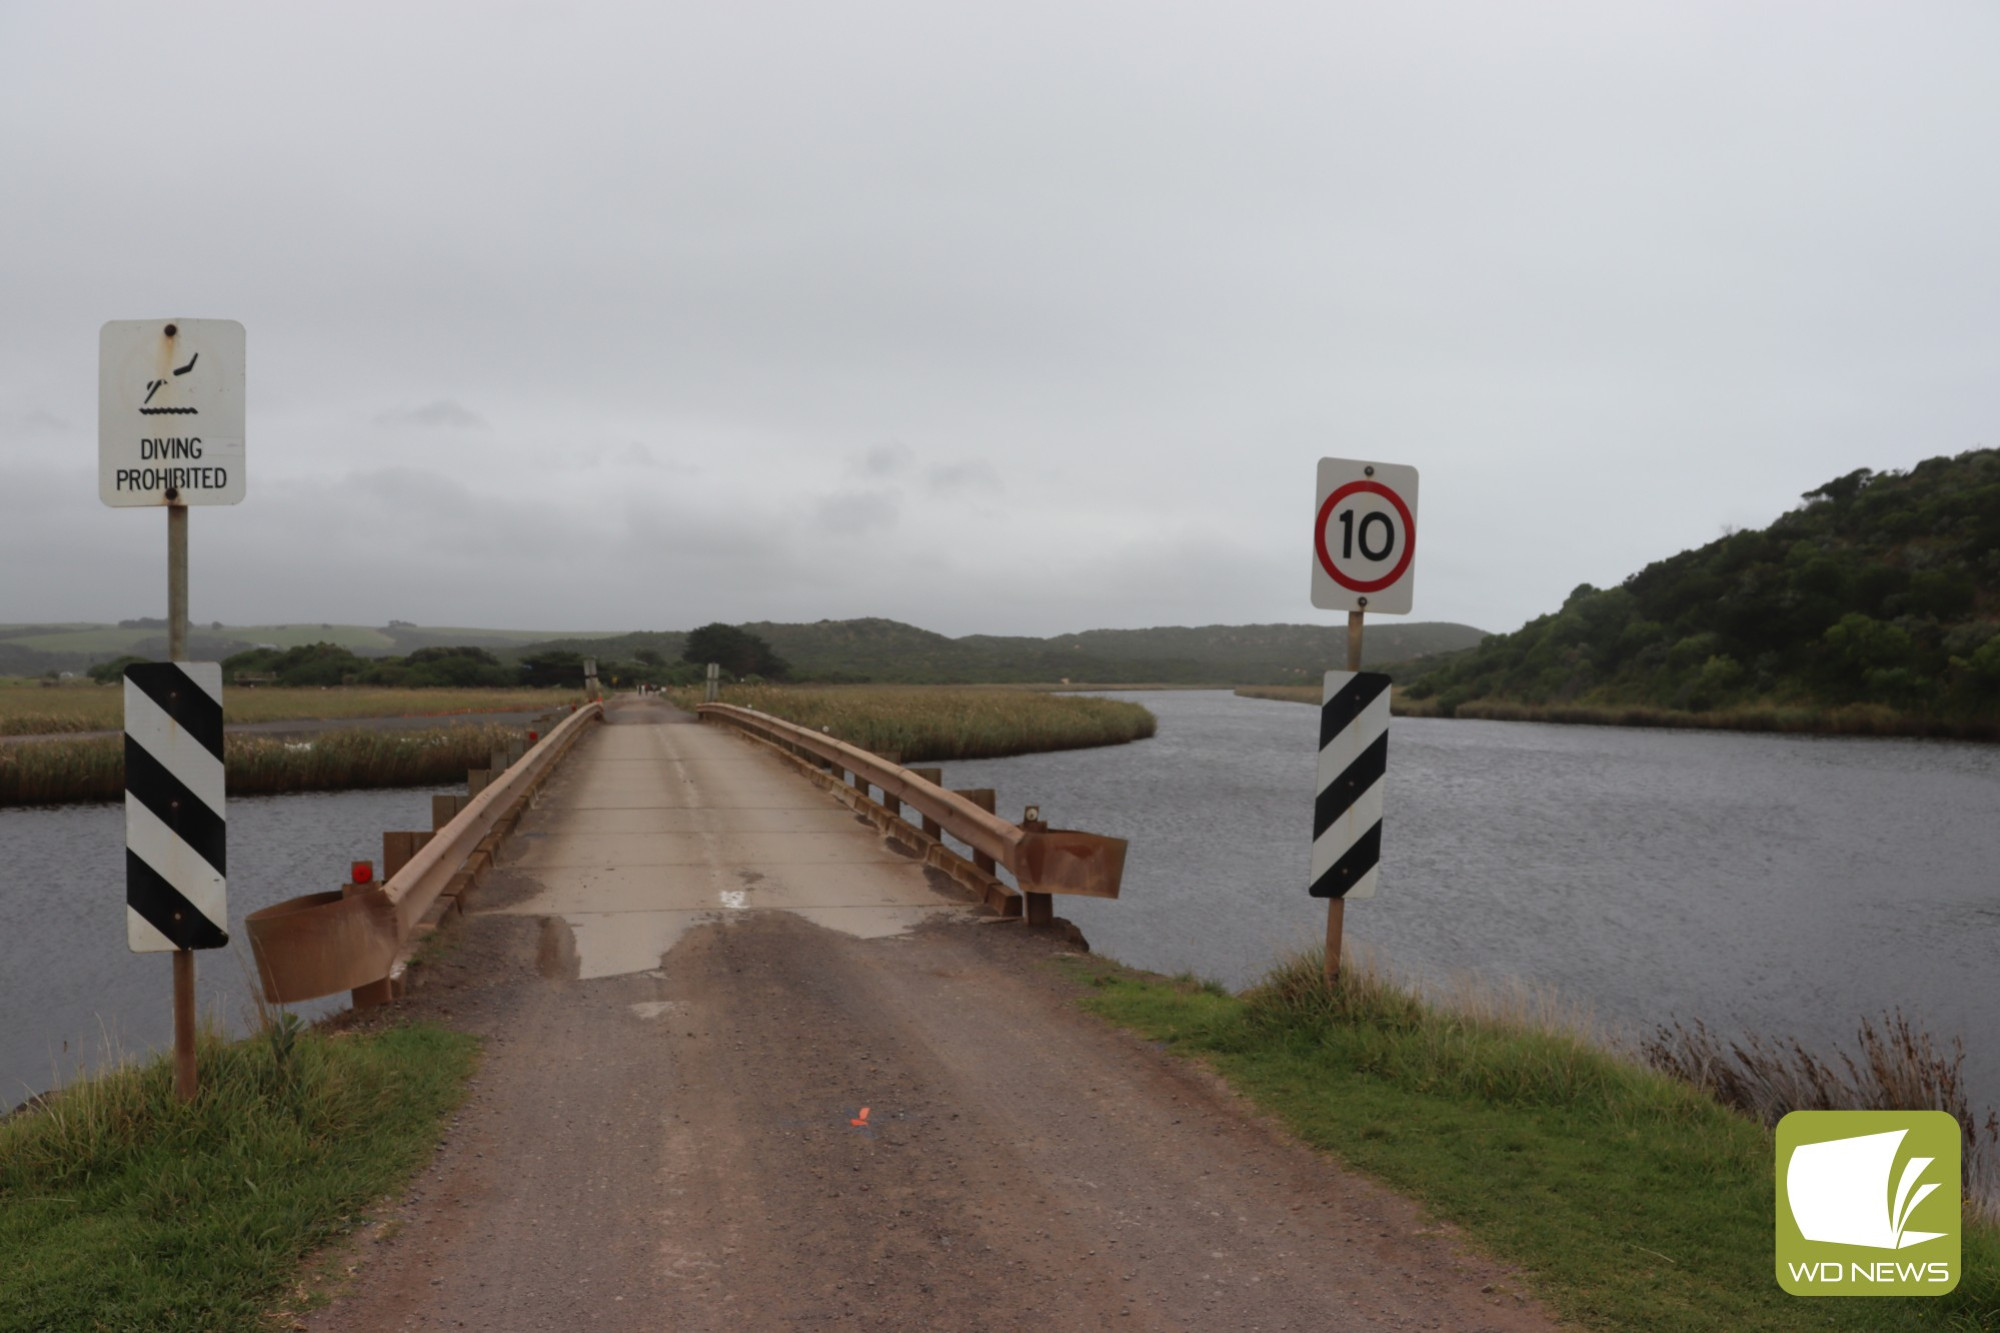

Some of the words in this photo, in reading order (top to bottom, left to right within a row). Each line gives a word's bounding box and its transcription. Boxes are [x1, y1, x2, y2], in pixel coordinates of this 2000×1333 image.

[141, 437, 203, 460] DIVING
[116, 467, 227, 490] PROHIBITED
[1339, 509, 1395, 562] 10
